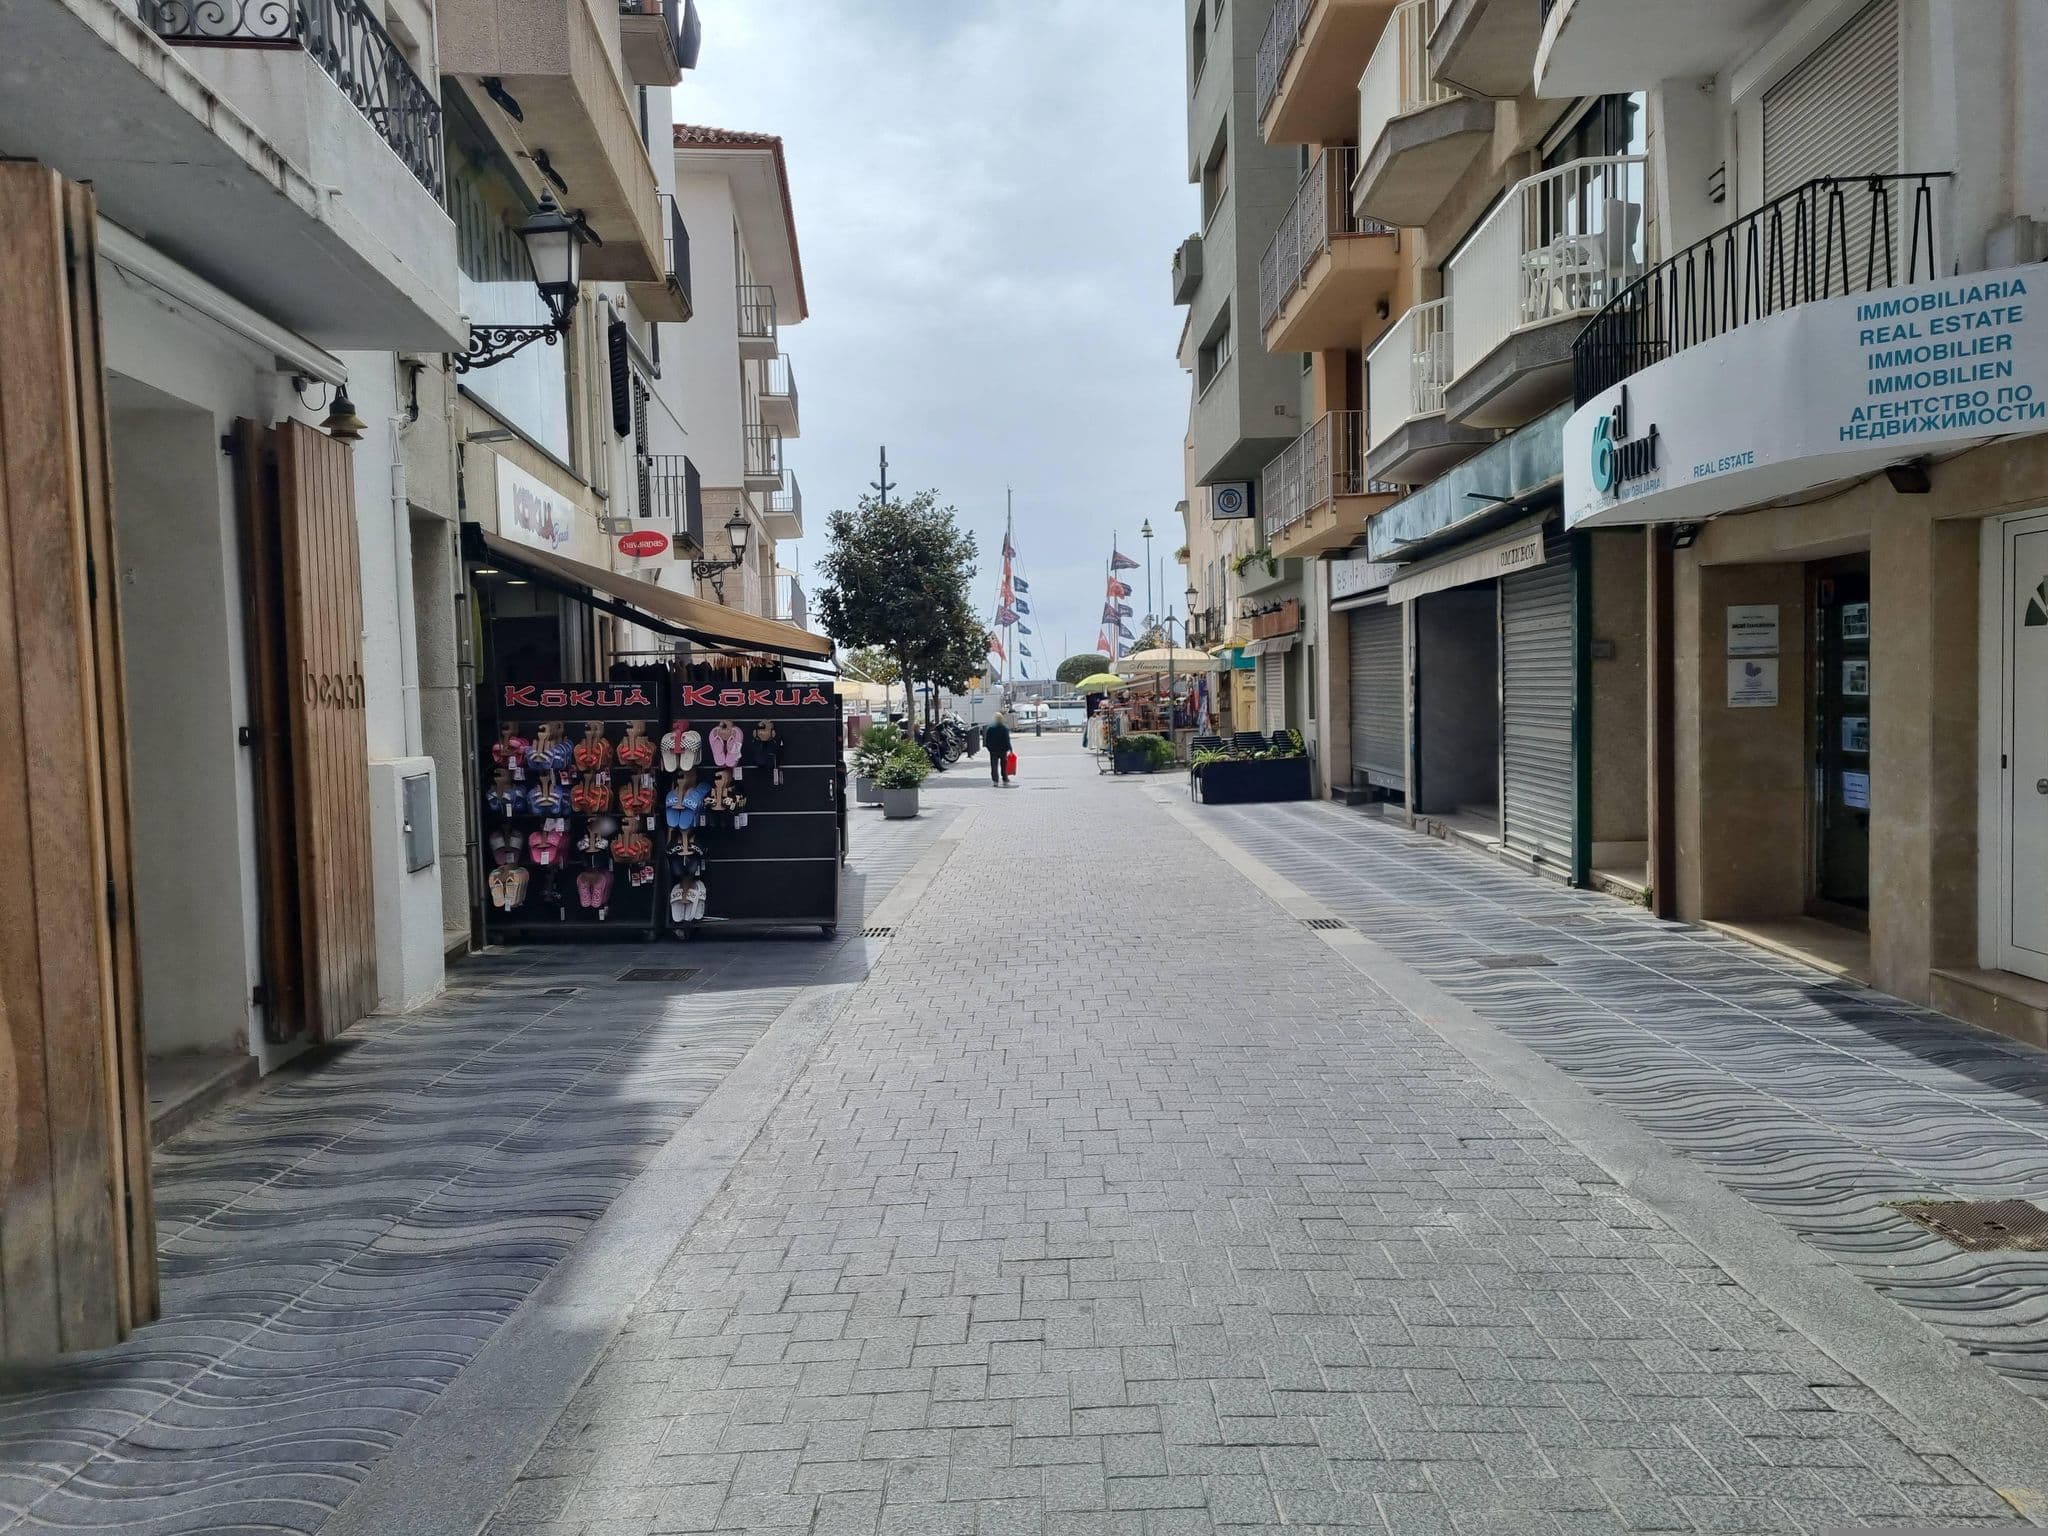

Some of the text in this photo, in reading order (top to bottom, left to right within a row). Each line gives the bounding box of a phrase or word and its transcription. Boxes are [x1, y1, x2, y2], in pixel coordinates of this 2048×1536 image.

[1857, 279, 2027, 322] IMMOBILIARIA
[1860, 305, 2023, 346] REAL ESTATE
[1868, 334, 2012, 370] IMMOBILIER
[1868, 359, 2012, 395] IMMOBILIEN
[1839, 402, 2045, 441] НЕДВИЖИМОСТИ
[1850, 385, 2033, 422] АГЕНТСТВО ПО
[1693, 451, 1754, 478] REAL ESTATE
